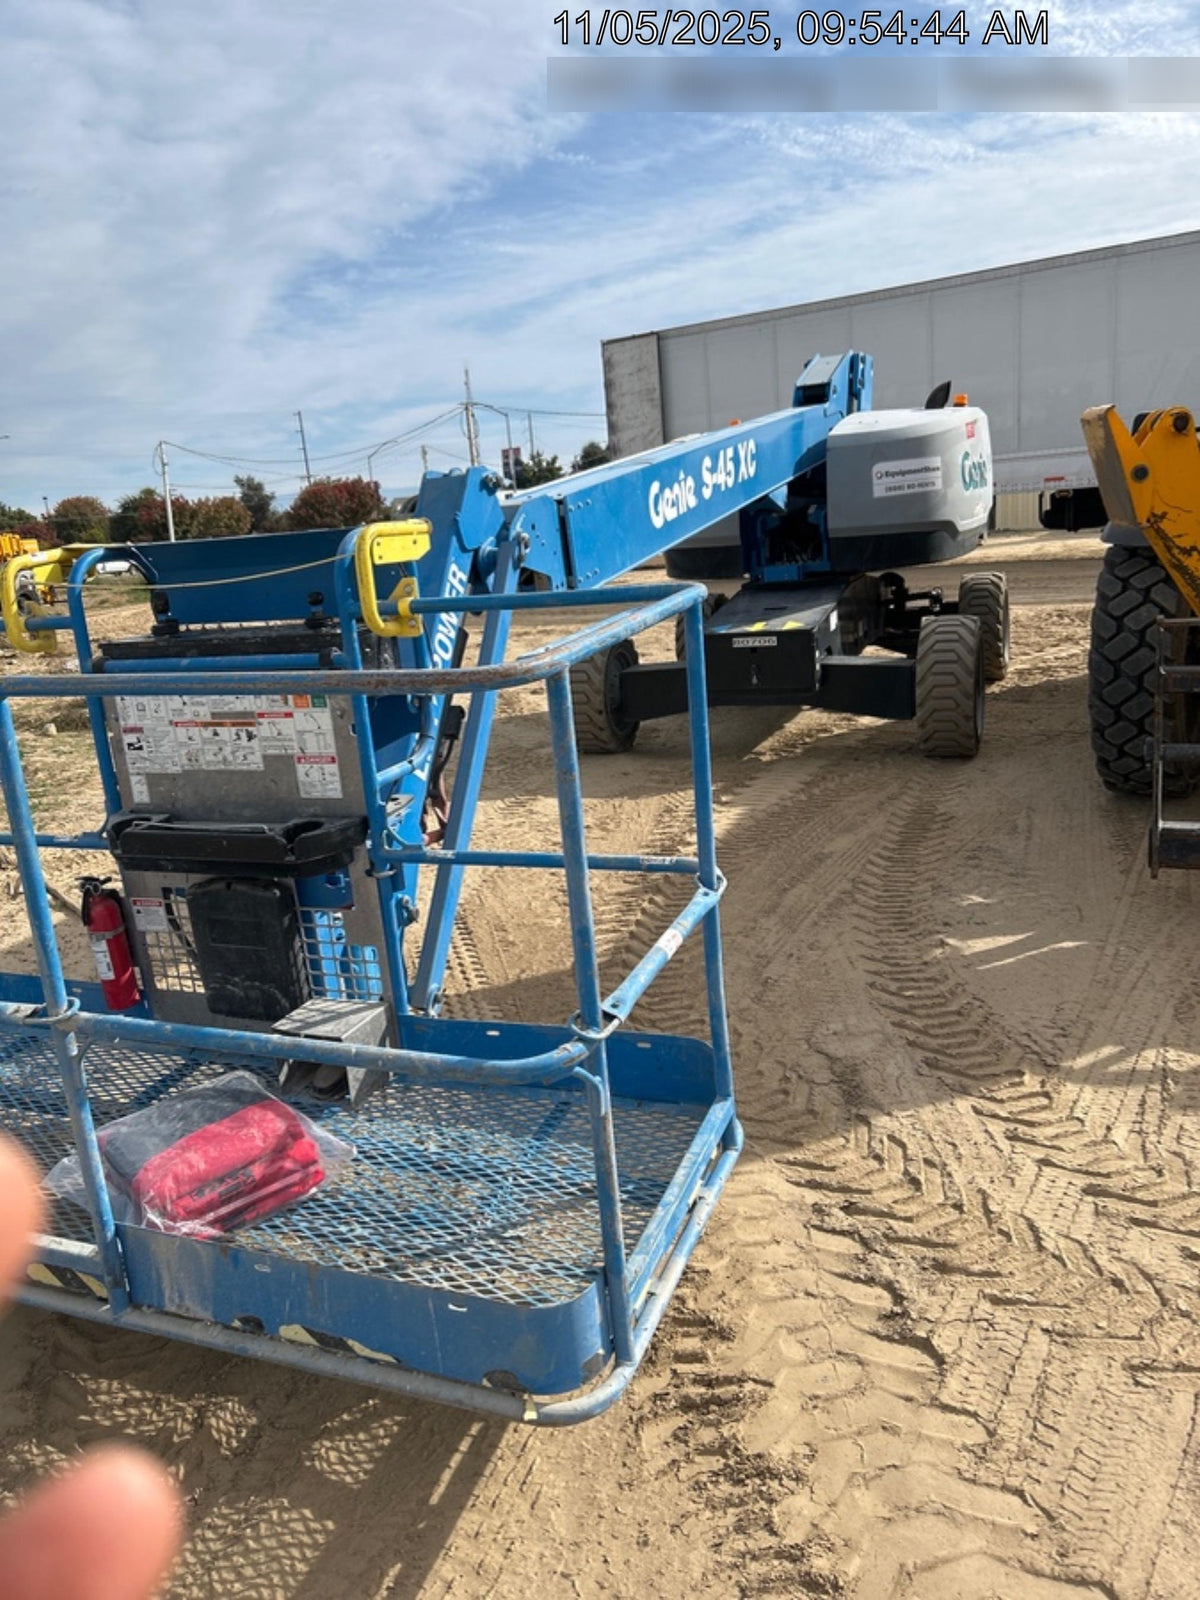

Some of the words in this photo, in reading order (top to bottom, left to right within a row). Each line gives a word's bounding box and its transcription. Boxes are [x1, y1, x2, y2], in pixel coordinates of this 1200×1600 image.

[648, 469, 698, 529] Genie
[702, 446, 735, 500] S-45
[738, 438, 757, 483] XC
